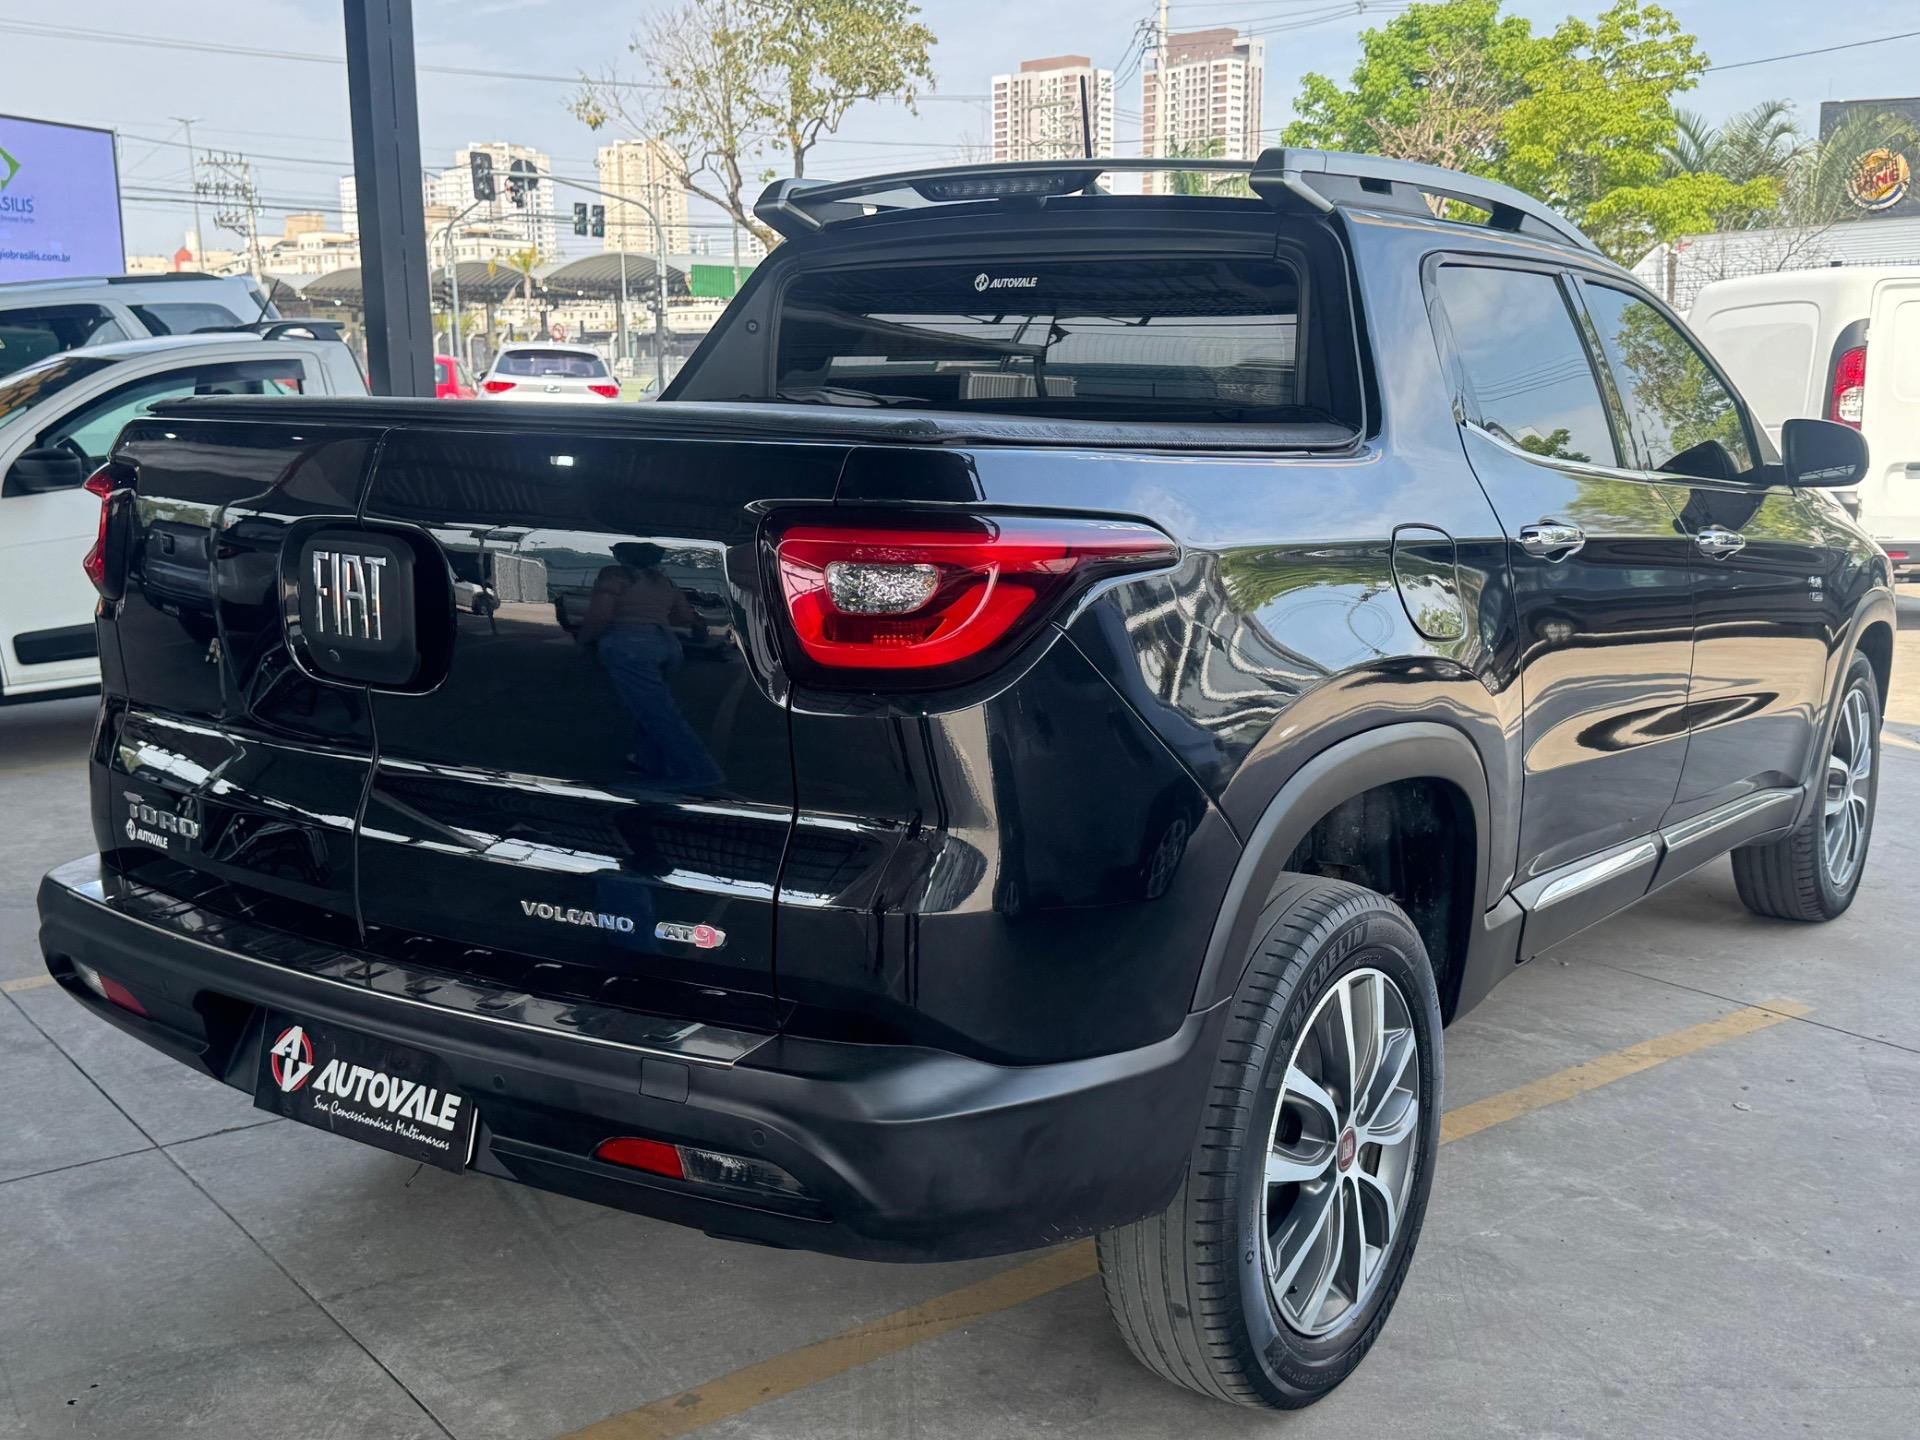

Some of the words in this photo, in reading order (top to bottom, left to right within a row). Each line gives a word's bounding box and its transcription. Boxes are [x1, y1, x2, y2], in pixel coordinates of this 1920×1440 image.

[989, 277, 1038, 288] AUTOVALE
[312, 550, 387, 641] FIAT
[123, 790, 201, 840] TORO
[136, 828, 169, 850] AUTOVALE
[519, 899, 634, 933] VOLCANO
[663, 923, 718, 950] AT9
[1289, 924, 1365, 1031] MICHELIN
[311, 1059, 462, 1131] AUTOVALE
[313, 1094, 330, 1112] Sua
[394, 1120, 451, 1151] Multimarcas
